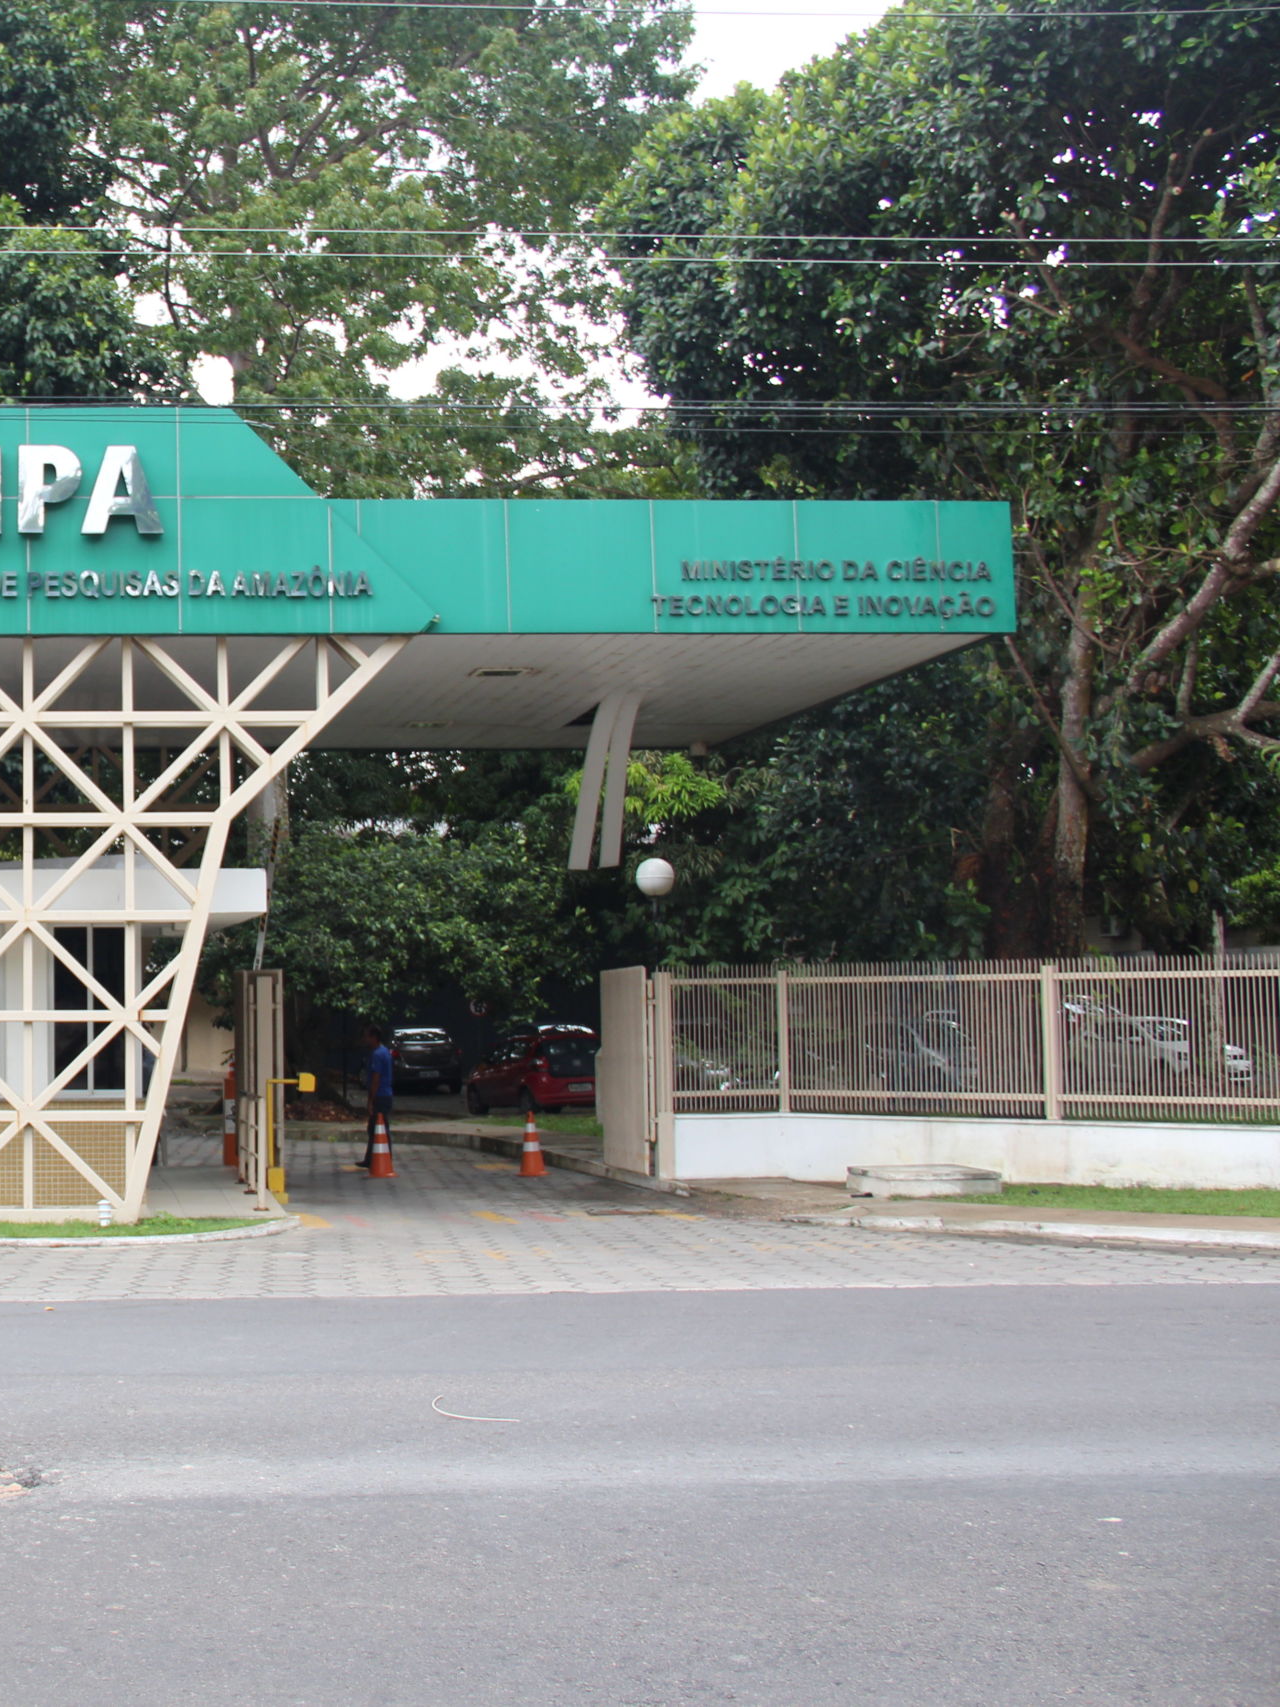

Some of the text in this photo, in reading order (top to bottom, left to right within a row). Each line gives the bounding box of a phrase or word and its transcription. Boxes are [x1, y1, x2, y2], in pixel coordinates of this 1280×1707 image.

[27, 569, 180, 599] PESQUISAS
[188, 569, 225, 597] DA
[231, 564, 373, 598] AMAZÔNIA
[681, 556, 992, 582] MINISTÉRIO DA CIÊNCIA
[651, 591, 996, 619] TECNOLOGIA E INOVAÇÃO
